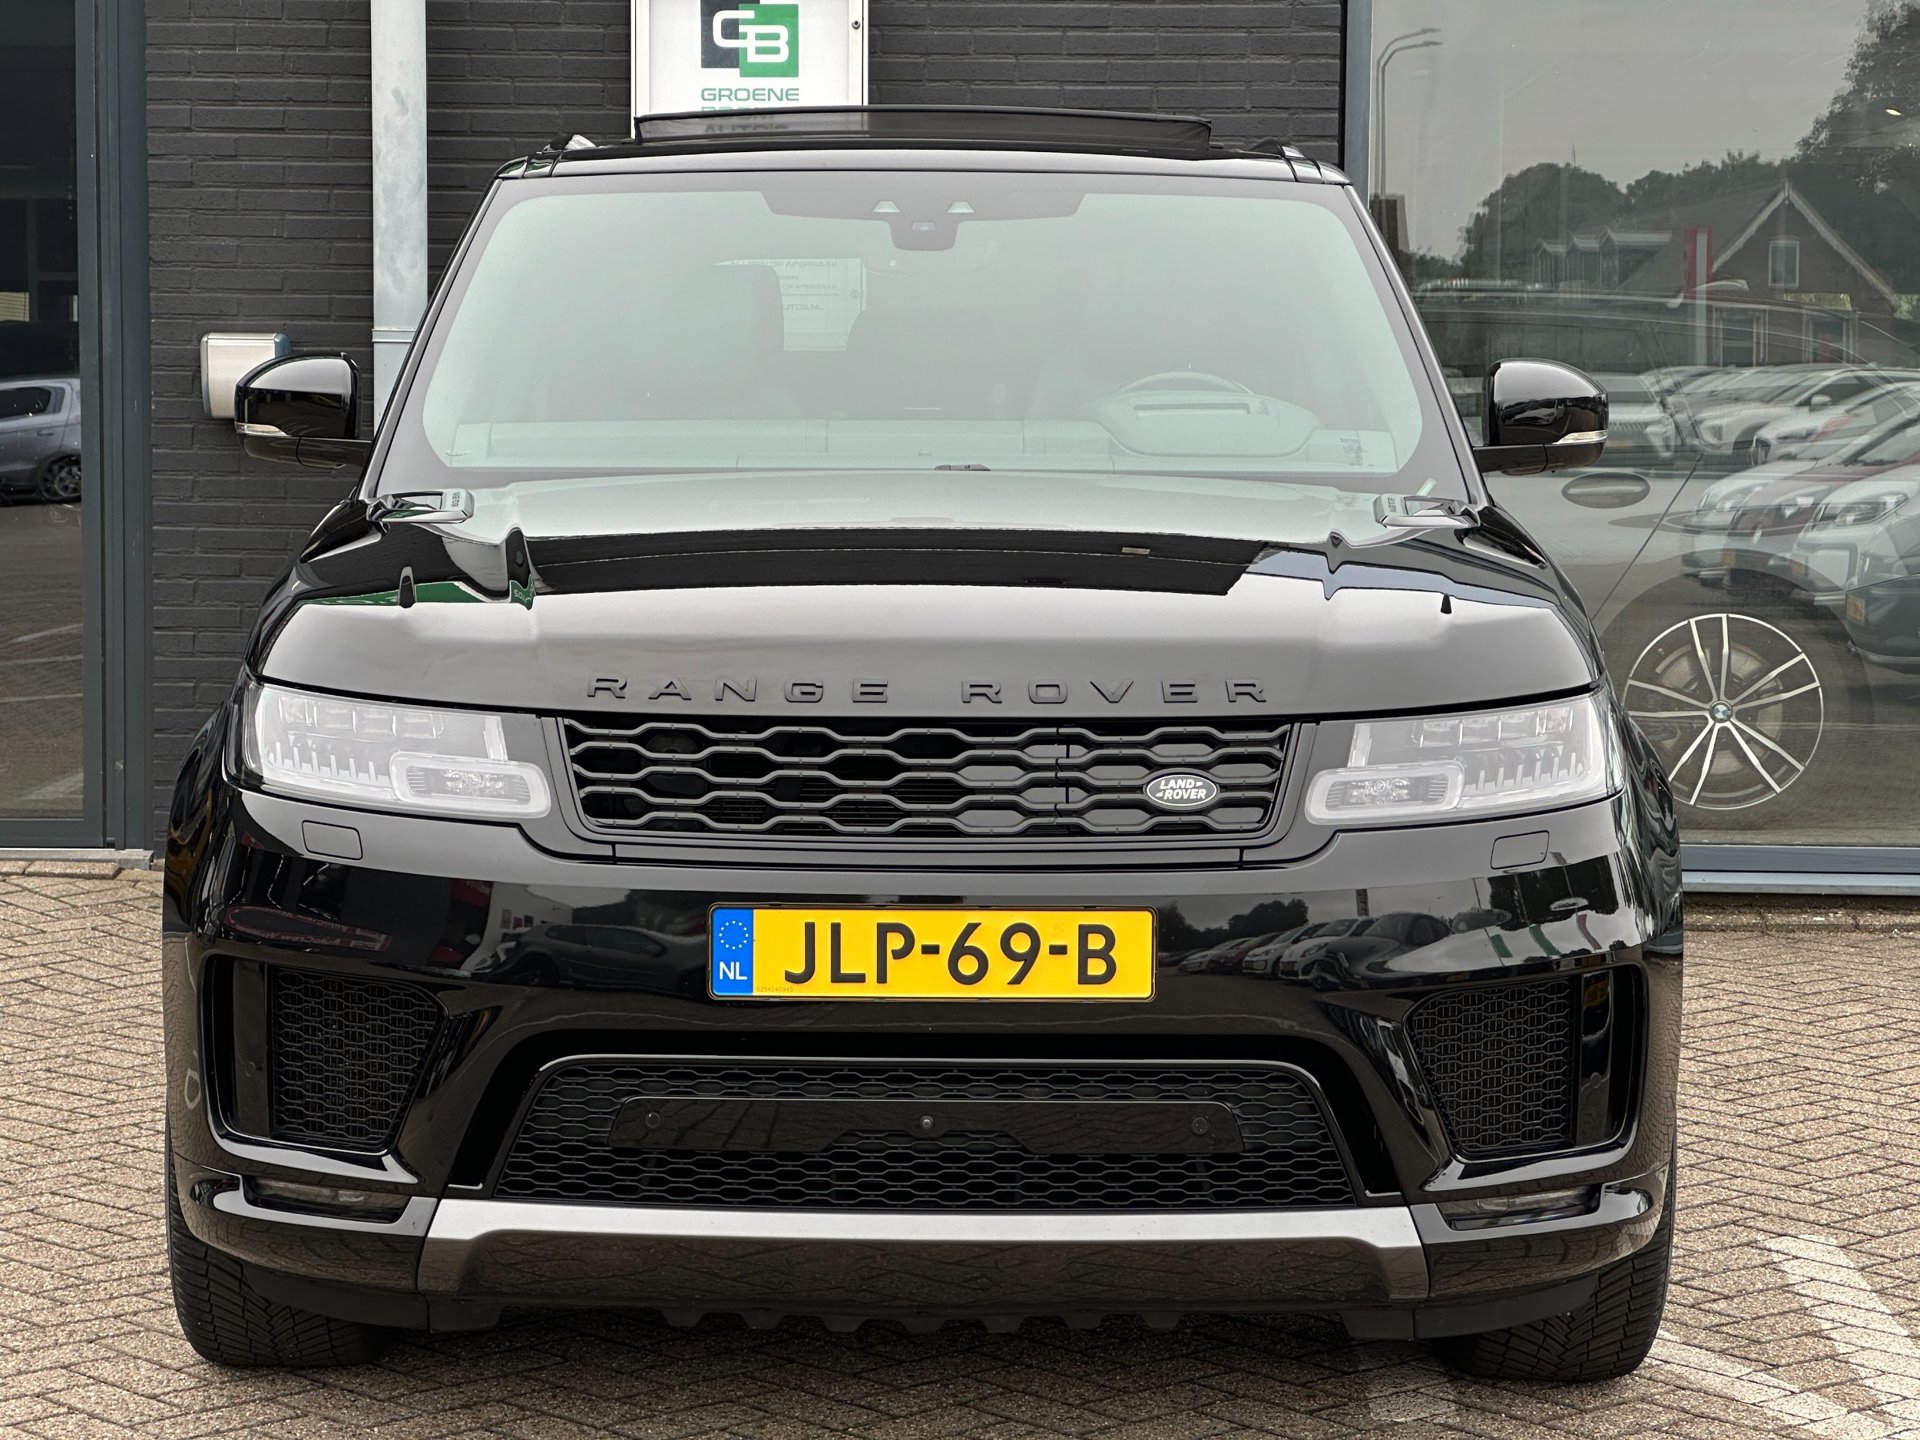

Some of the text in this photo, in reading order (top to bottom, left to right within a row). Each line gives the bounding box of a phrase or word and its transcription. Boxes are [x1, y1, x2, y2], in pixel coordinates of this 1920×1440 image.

[701, 87, 799, 101] GROENE
[586, 675, 1267, 704] RANGE ROVER
[1160, 779, 1195, 789] LAND
[1164, 788, 1207, 799] ROVER
[784, 921, 1118, 986] JLP-69-B
[718, 962, 748, 981] NL
